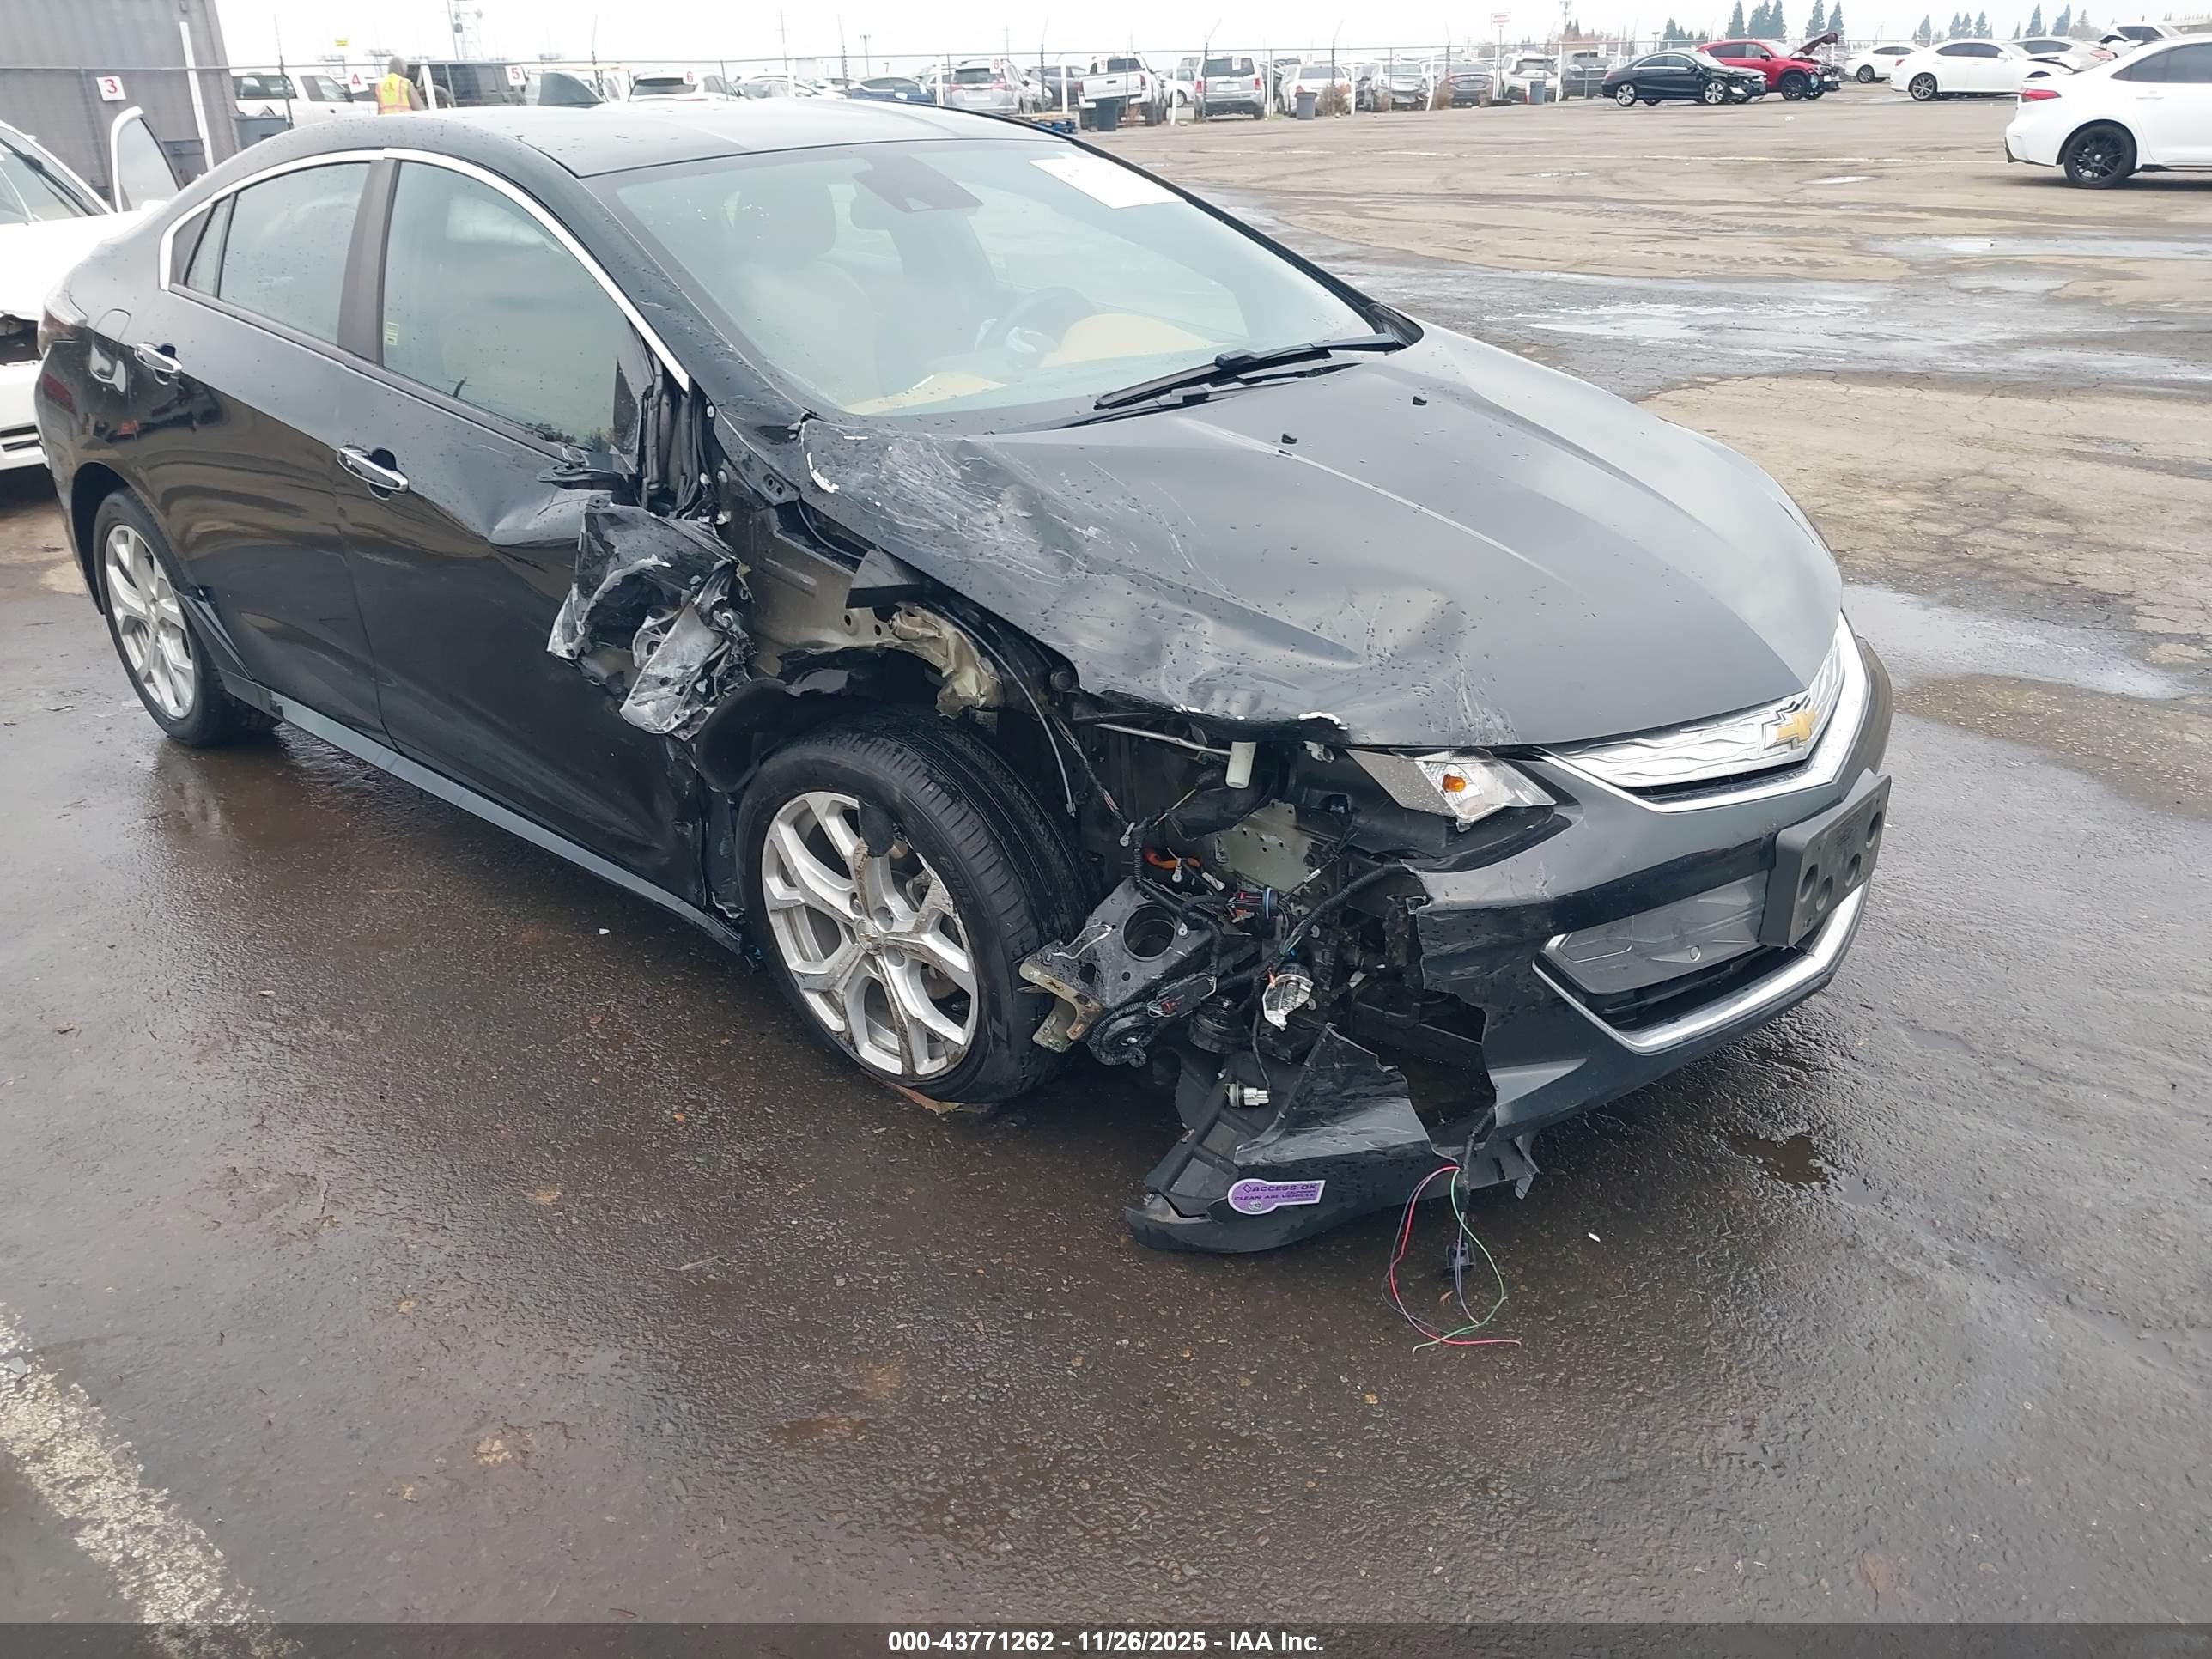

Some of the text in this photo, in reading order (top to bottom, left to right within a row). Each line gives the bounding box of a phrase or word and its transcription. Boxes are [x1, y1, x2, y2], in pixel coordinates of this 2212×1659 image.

[883, 62, 890, 74] 7
[994, 58, 1000, 70] 8
[352, 73, 362, 86] 4
[511, 67, 520, 80] 5
[686, 70, 694, 83] 6
[104, 78, 118, 94] 3
